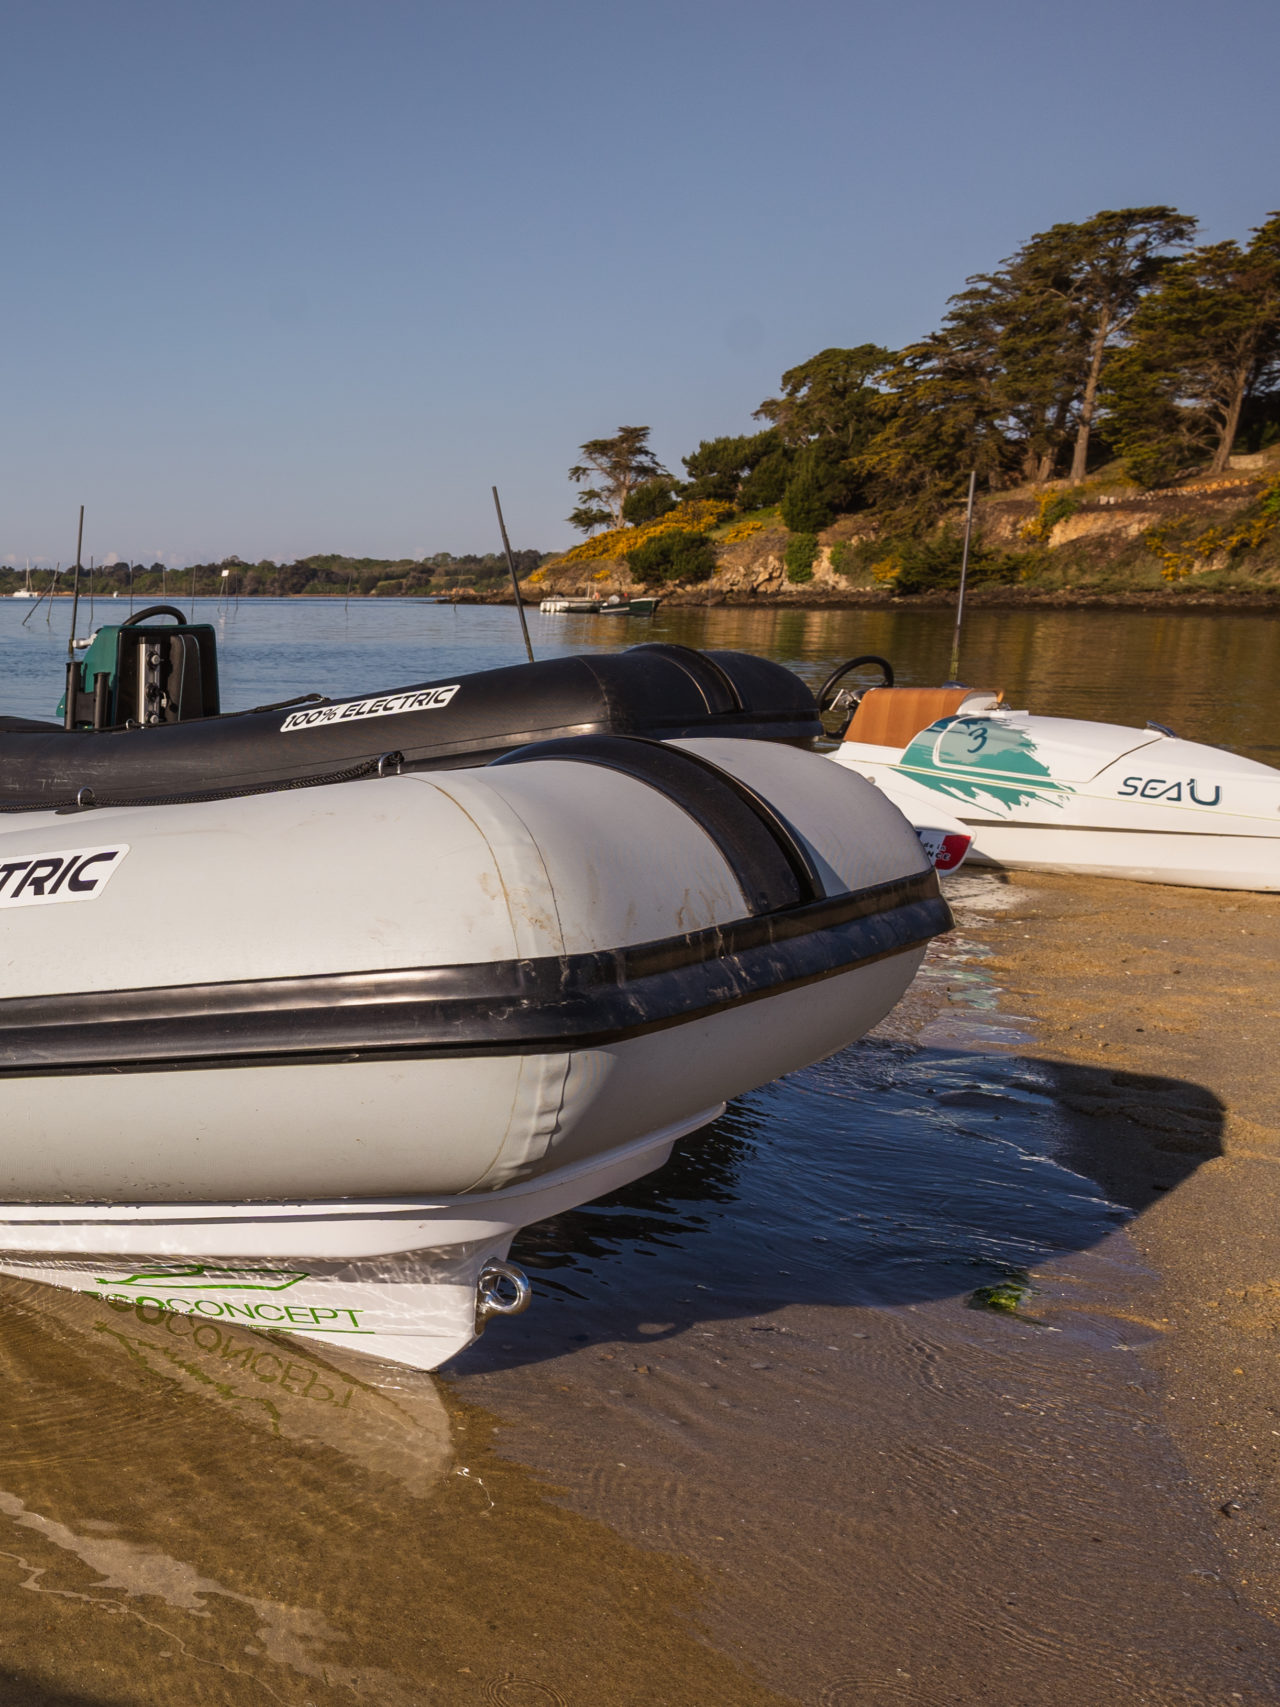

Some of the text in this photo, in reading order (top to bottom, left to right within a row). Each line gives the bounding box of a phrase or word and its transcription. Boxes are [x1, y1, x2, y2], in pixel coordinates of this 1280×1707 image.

[285, 687, 455, 728] 100% ELECTRIC
[967, 727, 988, 753] 3
